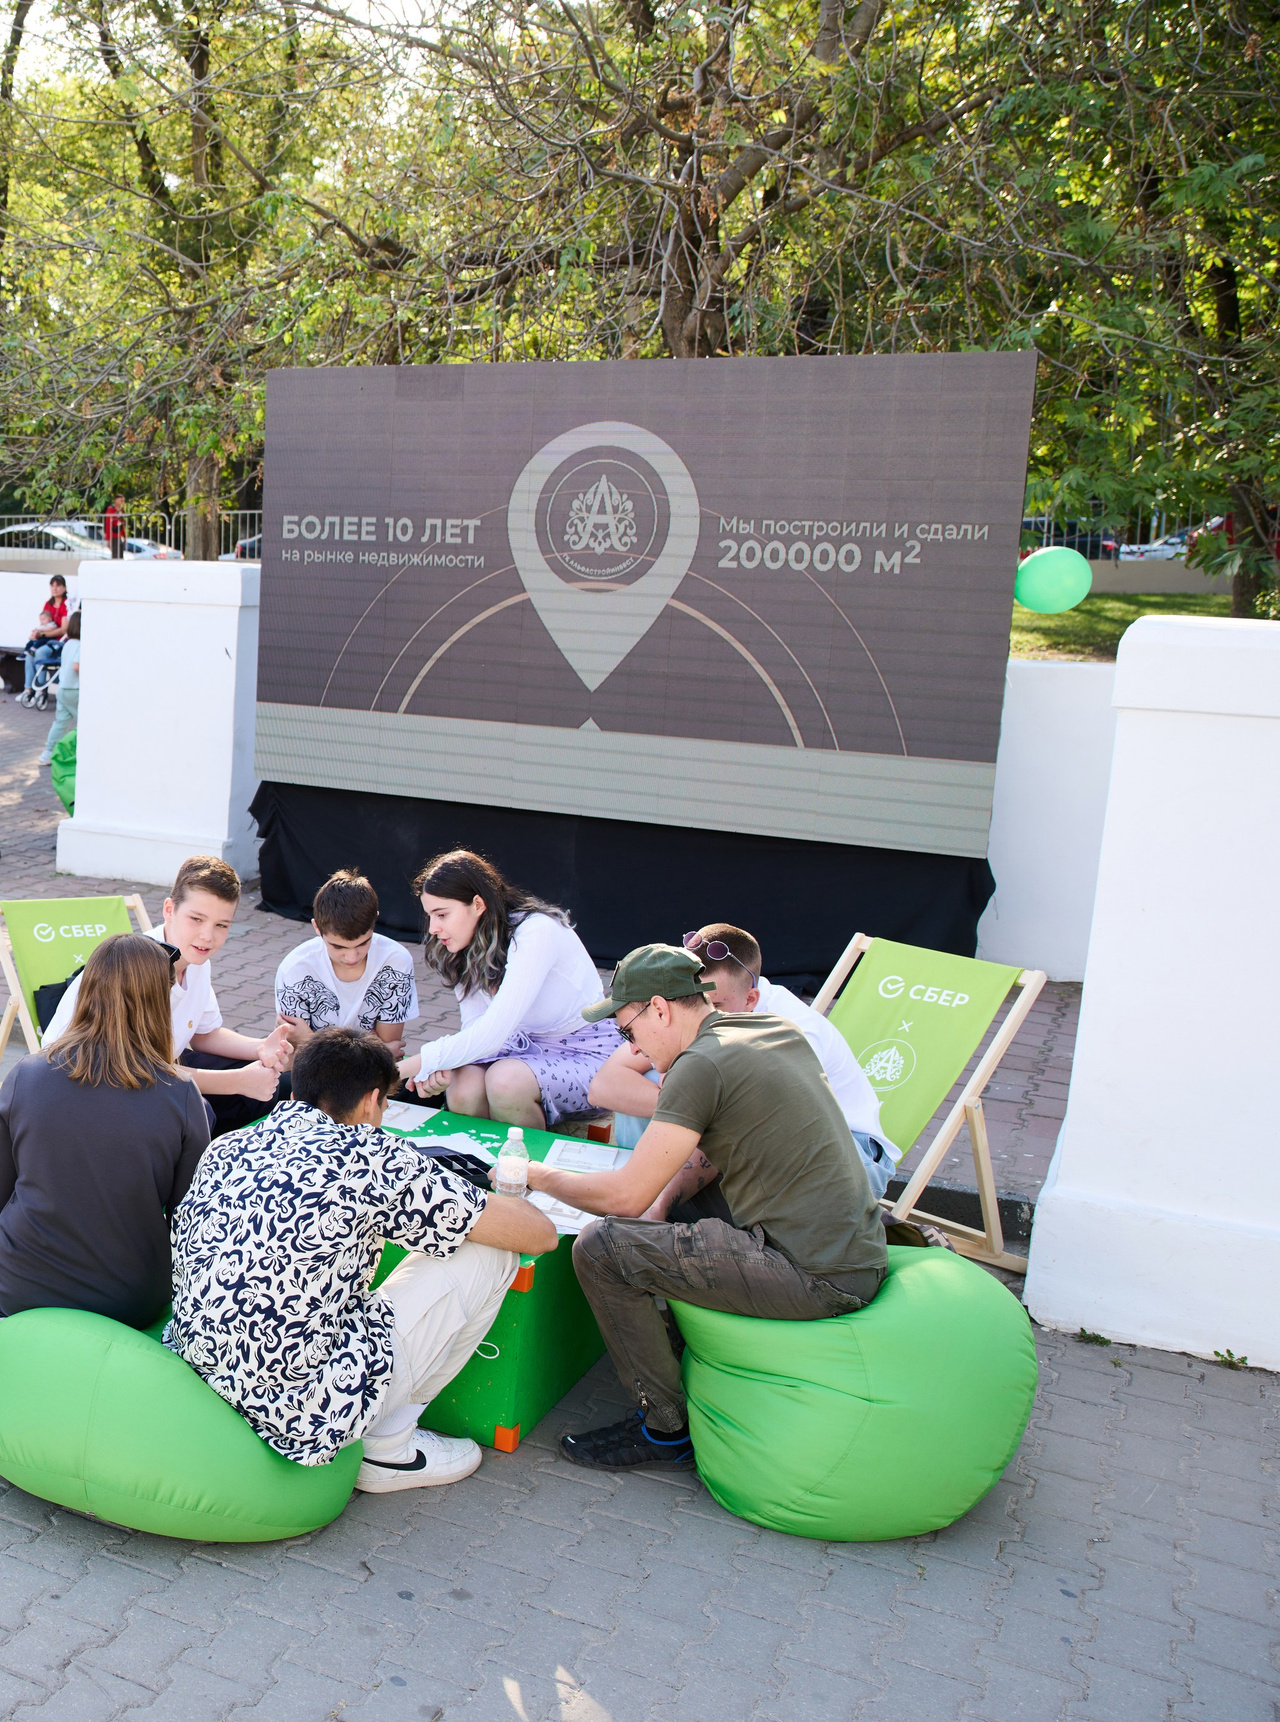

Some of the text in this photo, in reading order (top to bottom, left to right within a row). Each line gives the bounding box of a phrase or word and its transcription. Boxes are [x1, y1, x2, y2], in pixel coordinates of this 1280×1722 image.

[282, 515, 482, 544] БОЛЕЕ 10 ЛЕТ
[719, 516, 989, 543] Мы построили и сдали
[282, 549, 485, 568] на рынке недвижимости
[717, 539, 862, 573] 200000
[59, 923, 107, 938] СБЕР
[909, 984, 970, 1008] СБЕР
